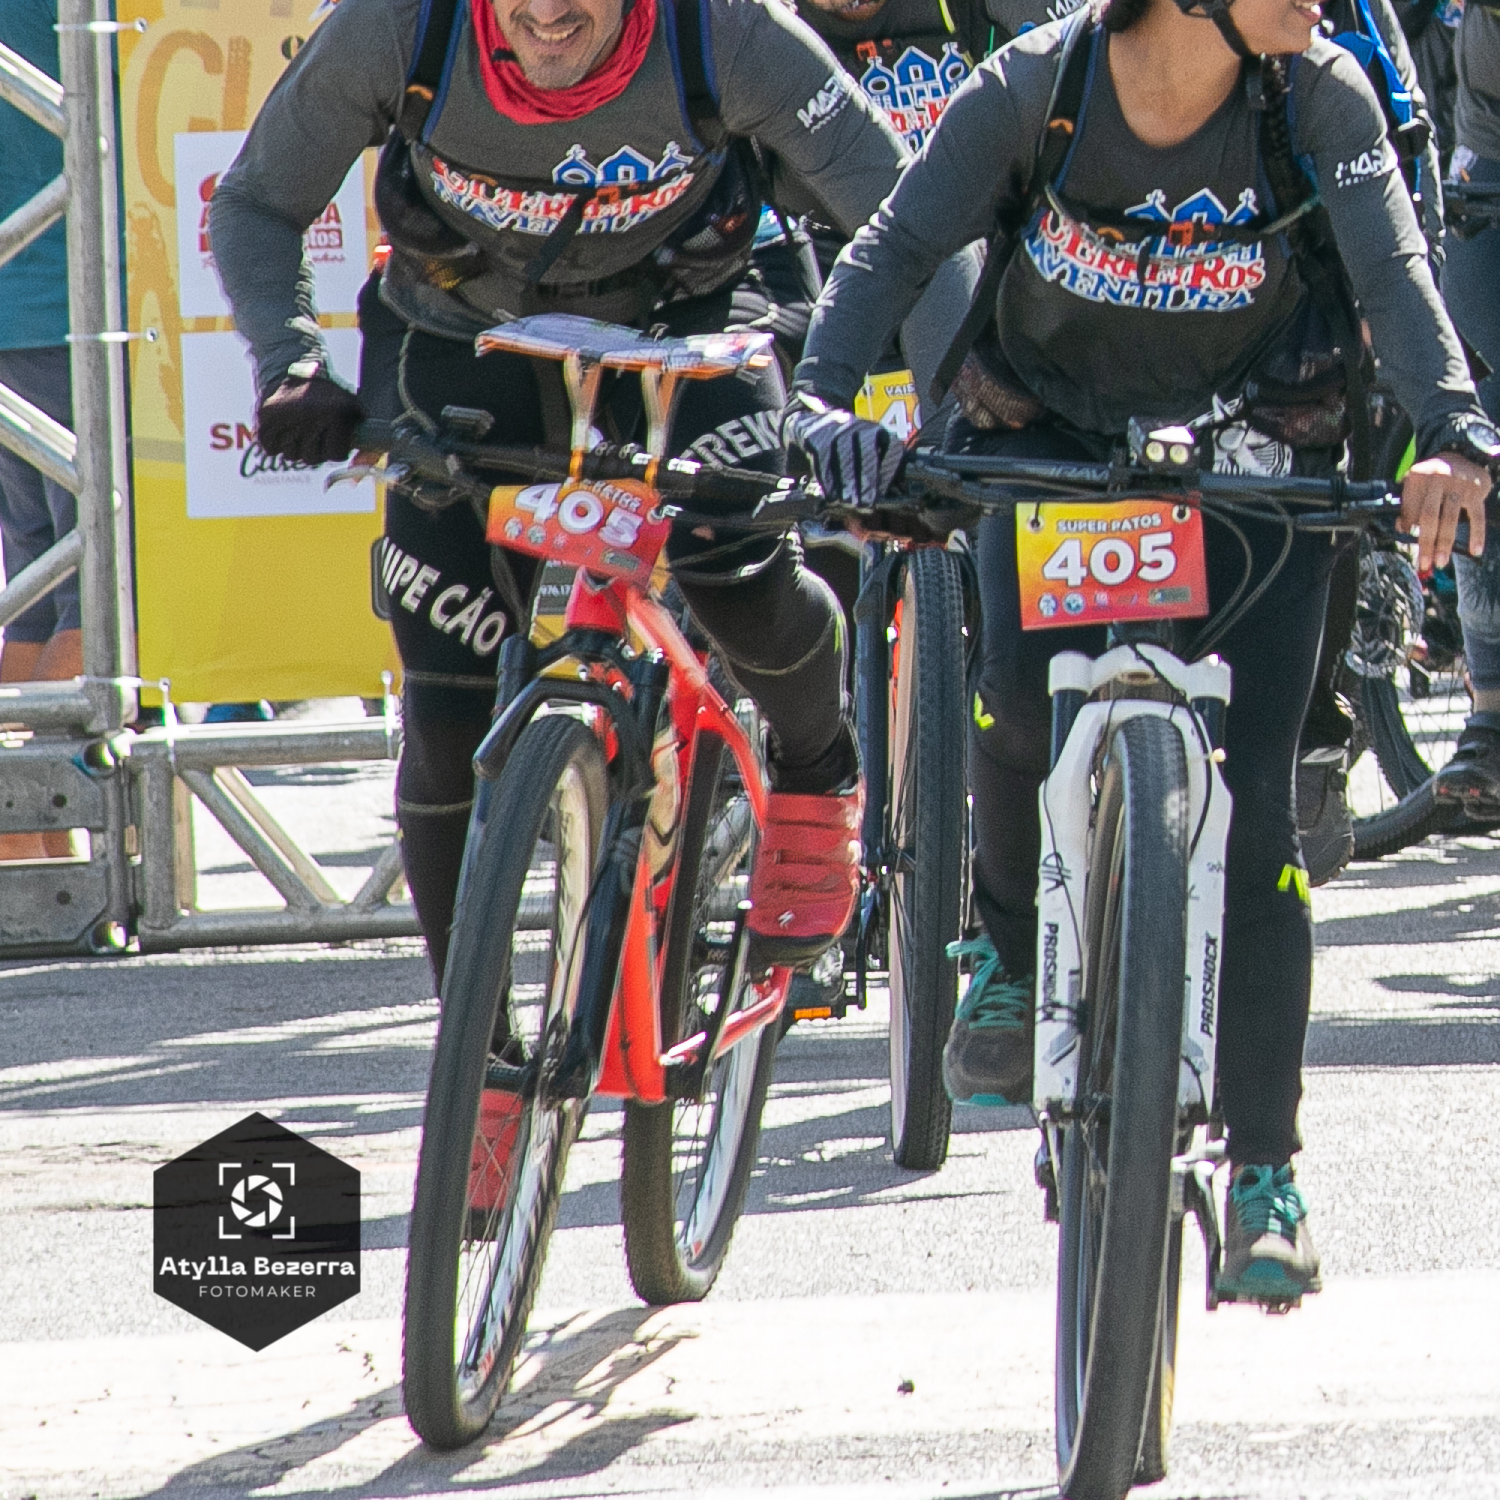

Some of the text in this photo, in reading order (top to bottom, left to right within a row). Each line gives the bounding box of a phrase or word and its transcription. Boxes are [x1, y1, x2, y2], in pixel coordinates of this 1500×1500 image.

[514, 482, 646, 551] 405
[1055, 512, 1162, 535] SUPER PATOS
[1041, 531, 1178, 587] 405
[1199, 929, 1219, 1039] PROSHOCK
